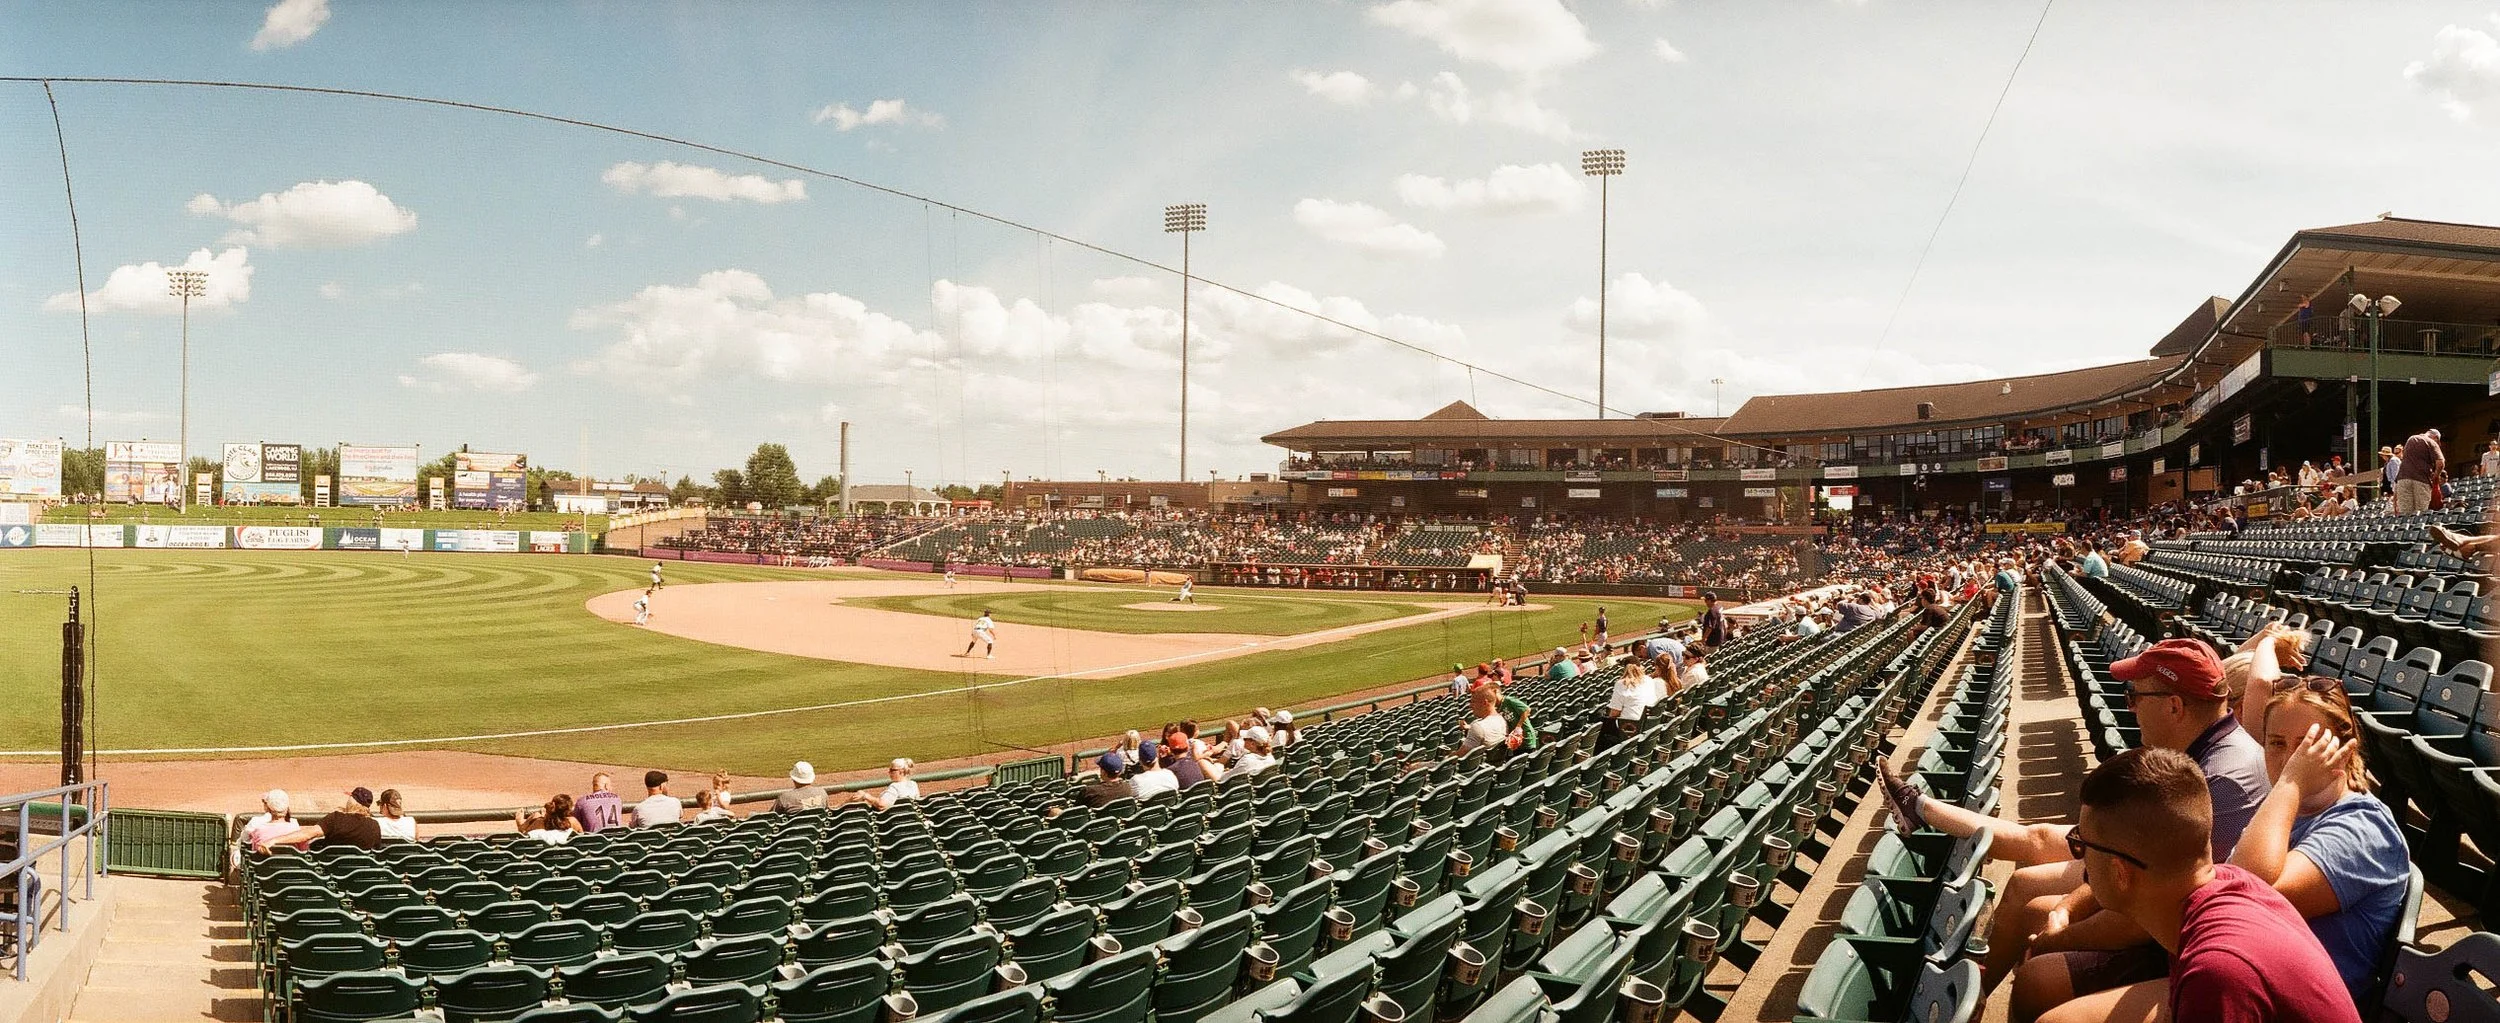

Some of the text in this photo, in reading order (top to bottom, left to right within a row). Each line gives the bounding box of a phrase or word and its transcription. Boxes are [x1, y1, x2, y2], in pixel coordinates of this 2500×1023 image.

[265, 446, 298, 454] CAMPING
[225, 445, 258, 468] WHITE CLAW
[265, 453, 298, 462] WORLD
[269, 529, 310, 537] PUGLISI
[594, 804, 619, 828] 14
